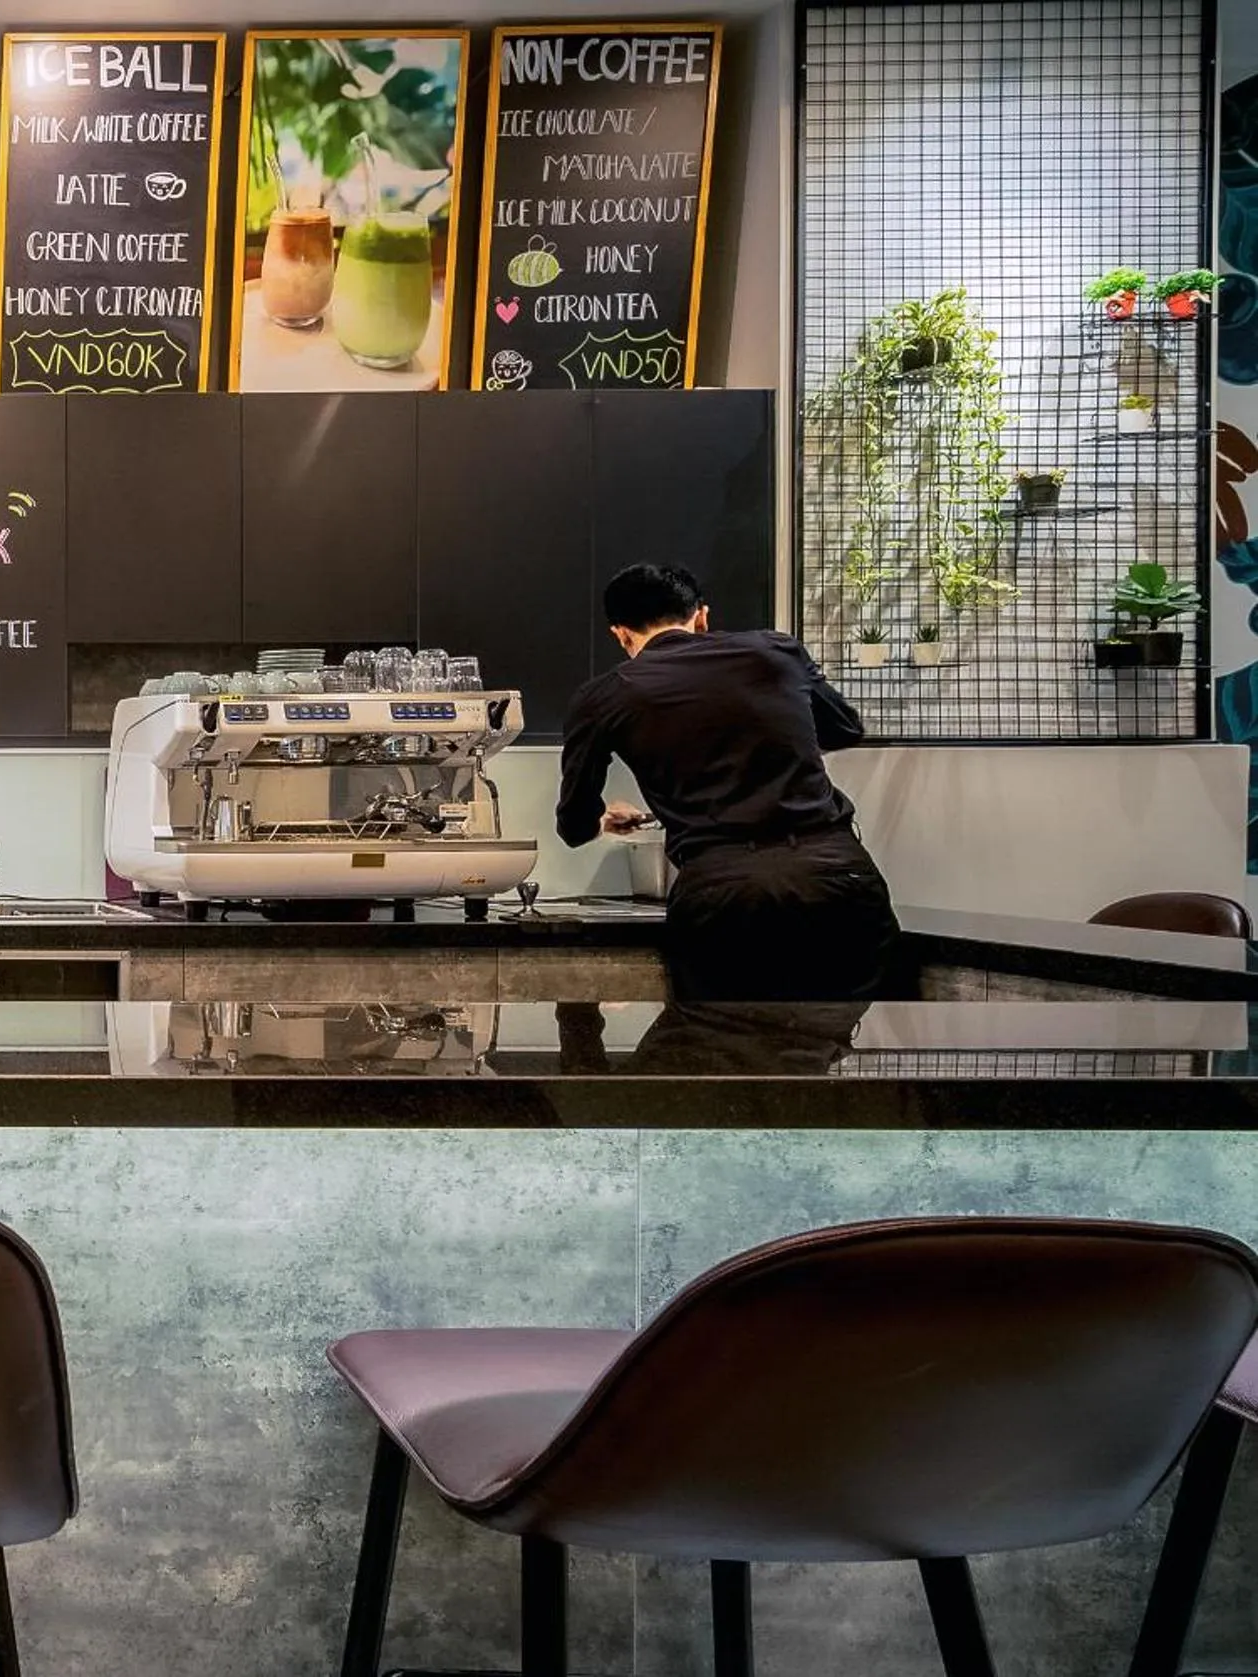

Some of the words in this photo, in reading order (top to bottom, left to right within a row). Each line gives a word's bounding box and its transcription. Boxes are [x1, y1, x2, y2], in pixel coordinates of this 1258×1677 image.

[26, 44, 92, 87] ICE
[99, 43, 208, 92] BALL
[500, 37, 710, 86] NON-COFFEE
[11, 112, 70, 144] MILK
[136, 112, 208, 143] COFFEE
[498, 110, 534, 137] ICE
[535, 108, 636, 136] CHOCOLATE
[56, 173, 130, 206] LATTE
[494, 199, 533, 228] ICE
[537, 196, 586, 226] MILK
[590, 195, 697, 225] COCONUT
[26, 231, 110, 262] GREEN
[116, 233, 189, 263] COFFEE
[585, 243, 660, 274] HONEY
[5, 286, 91, 316] HONEY
[534, 294, 612, 323] CITRON
[614, 292, 659, 321] TEA
